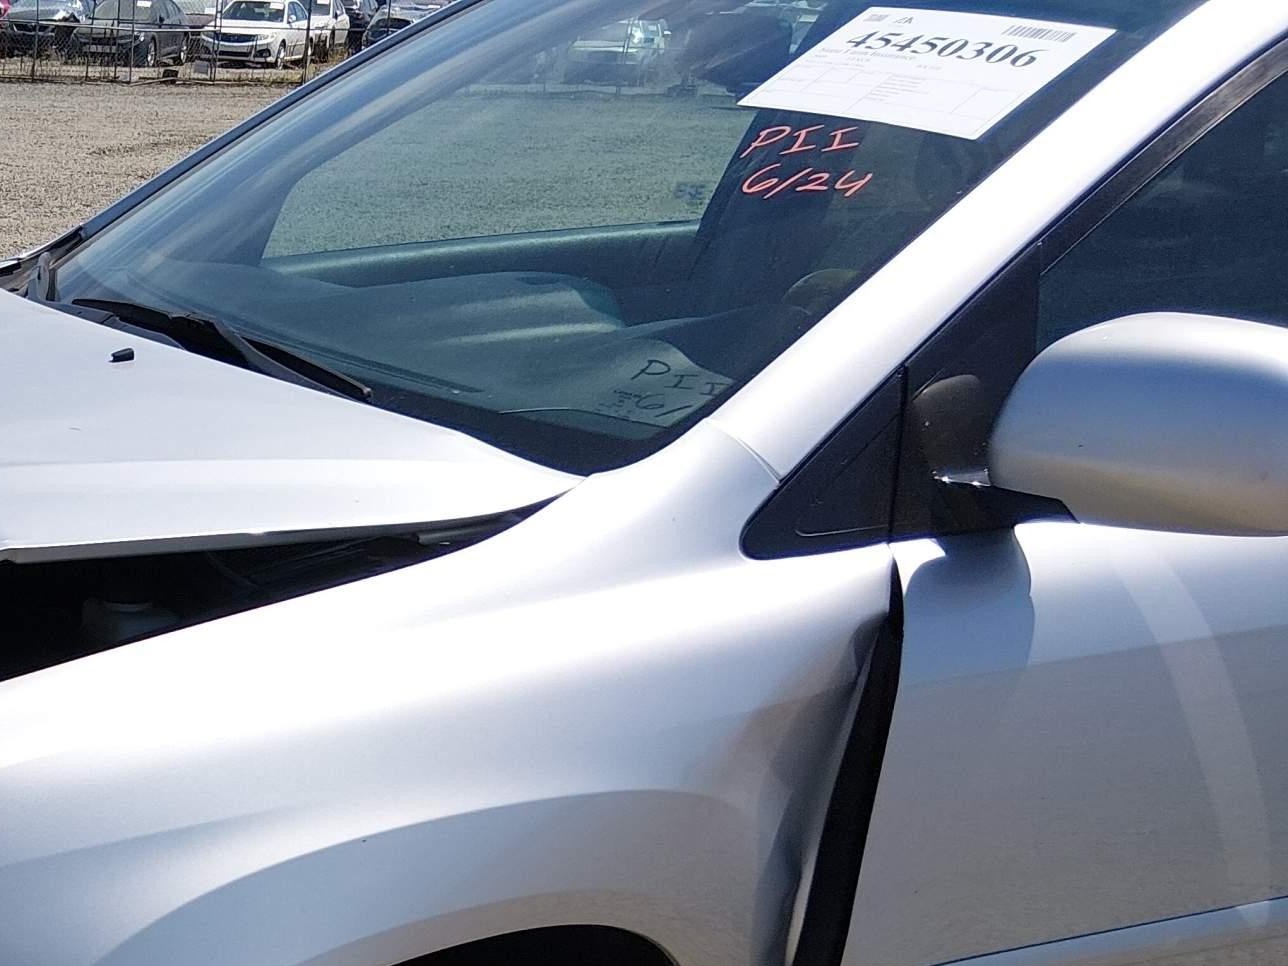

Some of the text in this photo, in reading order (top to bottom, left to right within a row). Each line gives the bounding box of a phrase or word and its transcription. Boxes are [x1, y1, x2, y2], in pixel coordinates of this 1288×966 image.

[844, 30, 1050, 68] 45450306
[740, 124, 860, 158] PII
[741, 162, 873, 199] 6/24
